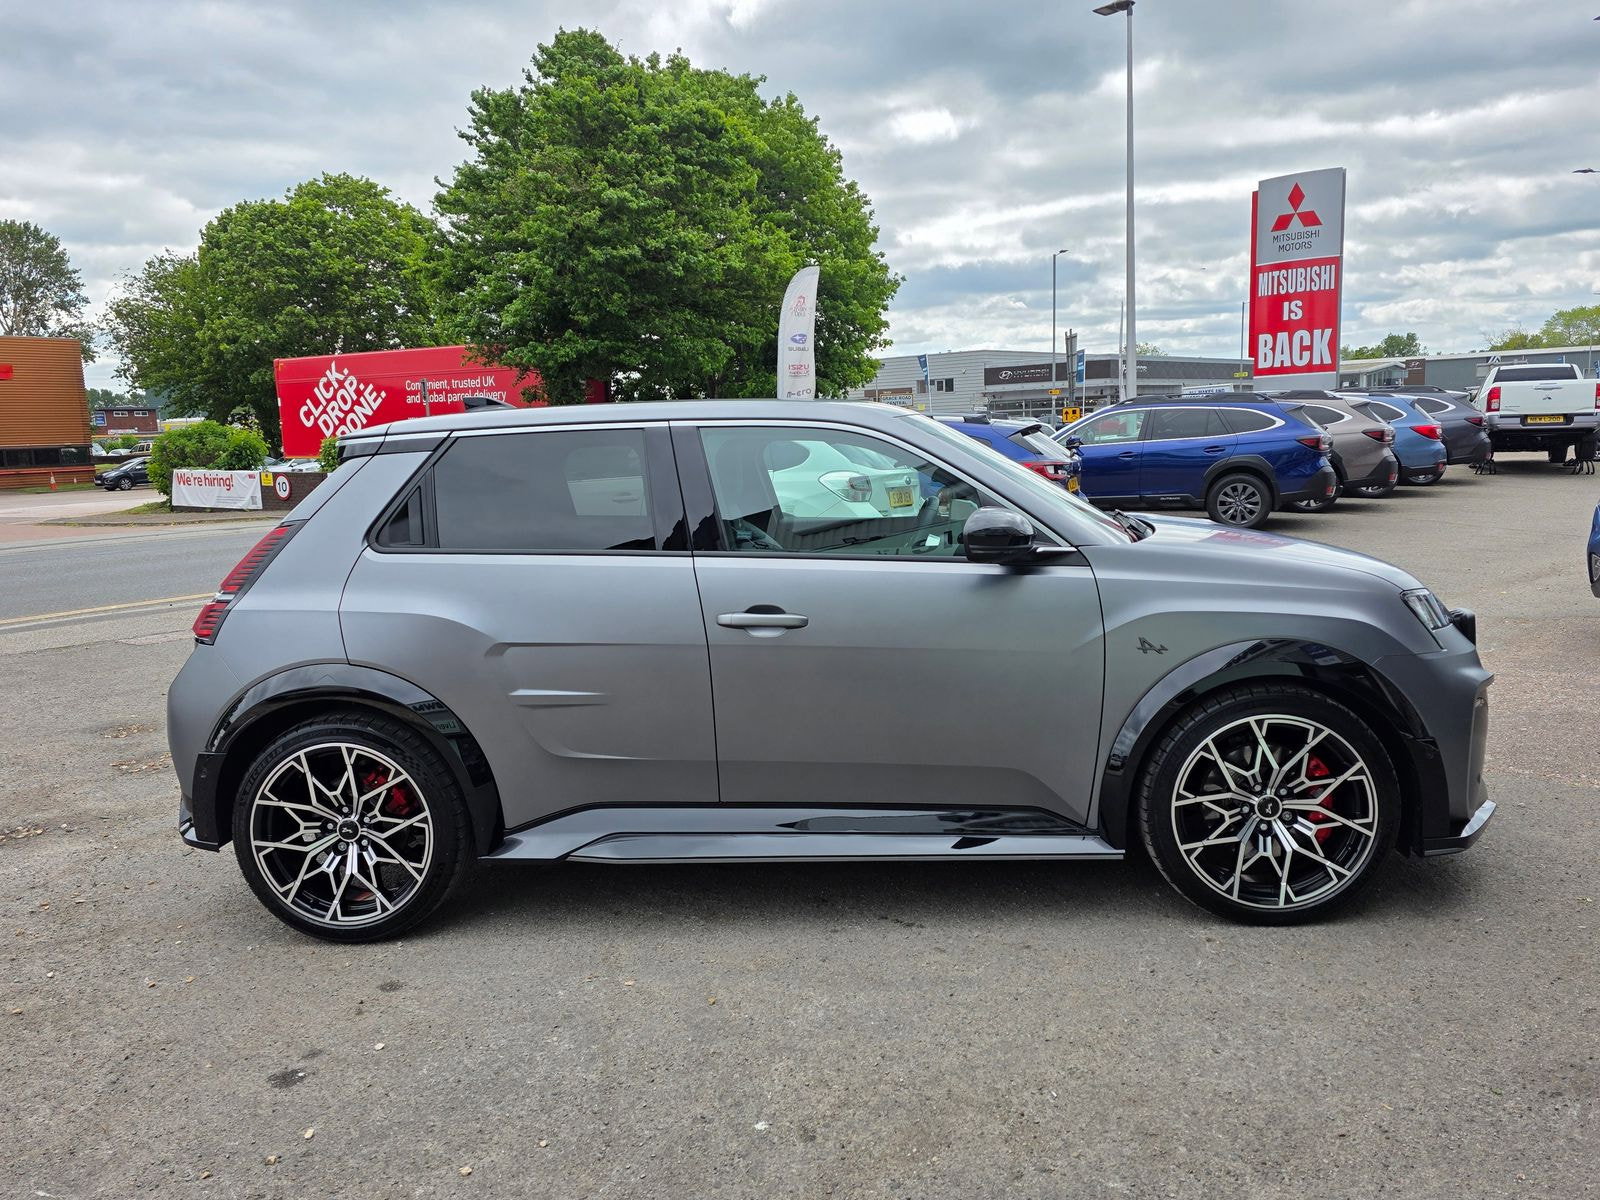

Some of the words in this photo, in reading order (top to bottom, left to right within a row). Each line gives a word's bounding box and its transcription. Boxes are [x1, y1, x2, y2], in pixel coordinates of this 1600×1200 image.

[1272, 229, 1320, 244] MITSUBISHI
[1278, 241, 1312, 252] MOTORS
[1258, 264, 1336, 297] MITSUBISHI
[1283, 300, 1303, 321] IS
[1258, 328, 1333, 369] BACK
[405, 379, 450, 391] Connient,
[451, 377, 480, 388] trusted
[482, 375, 496, 387] UK
[299, 360, 349, 428] CLICK.
[406, 393, 420, 403] and
[423, 391, 446, 405] obal
[317, 375, 365, 438] DROP.
[176, 472, 203, 487] We're
[203, 473, 234, 491] hiring!
[277, 481, 288, 492] 10
